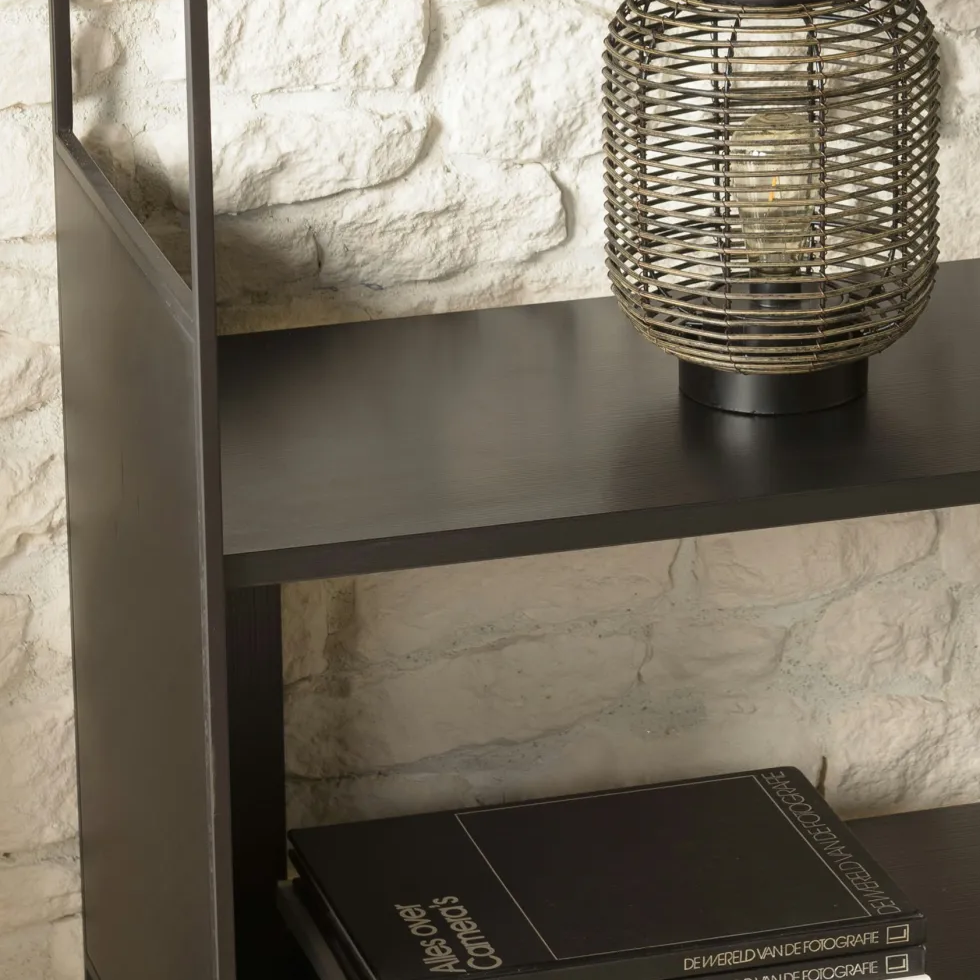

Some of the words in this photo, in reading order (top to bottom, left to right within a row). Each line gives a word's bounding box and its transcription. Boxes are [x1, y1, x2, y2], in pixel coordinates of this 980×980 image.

[394, 904, 438, 937] over
[870, 900, 902, 915] DE
[428, 895, 503, 970] Camera's
[420, 938, 467, 972] Alles
[683, 955, 701, 971] DE
[702, 948, 756, 969] WERELD
[757, 944, 784, 961] VAN
[784, 941, 802, 956] DE
[803, 931, 880, 953] FOTOGRAFIE
[802, 960, 879, 980] FOTOGRAFIE
